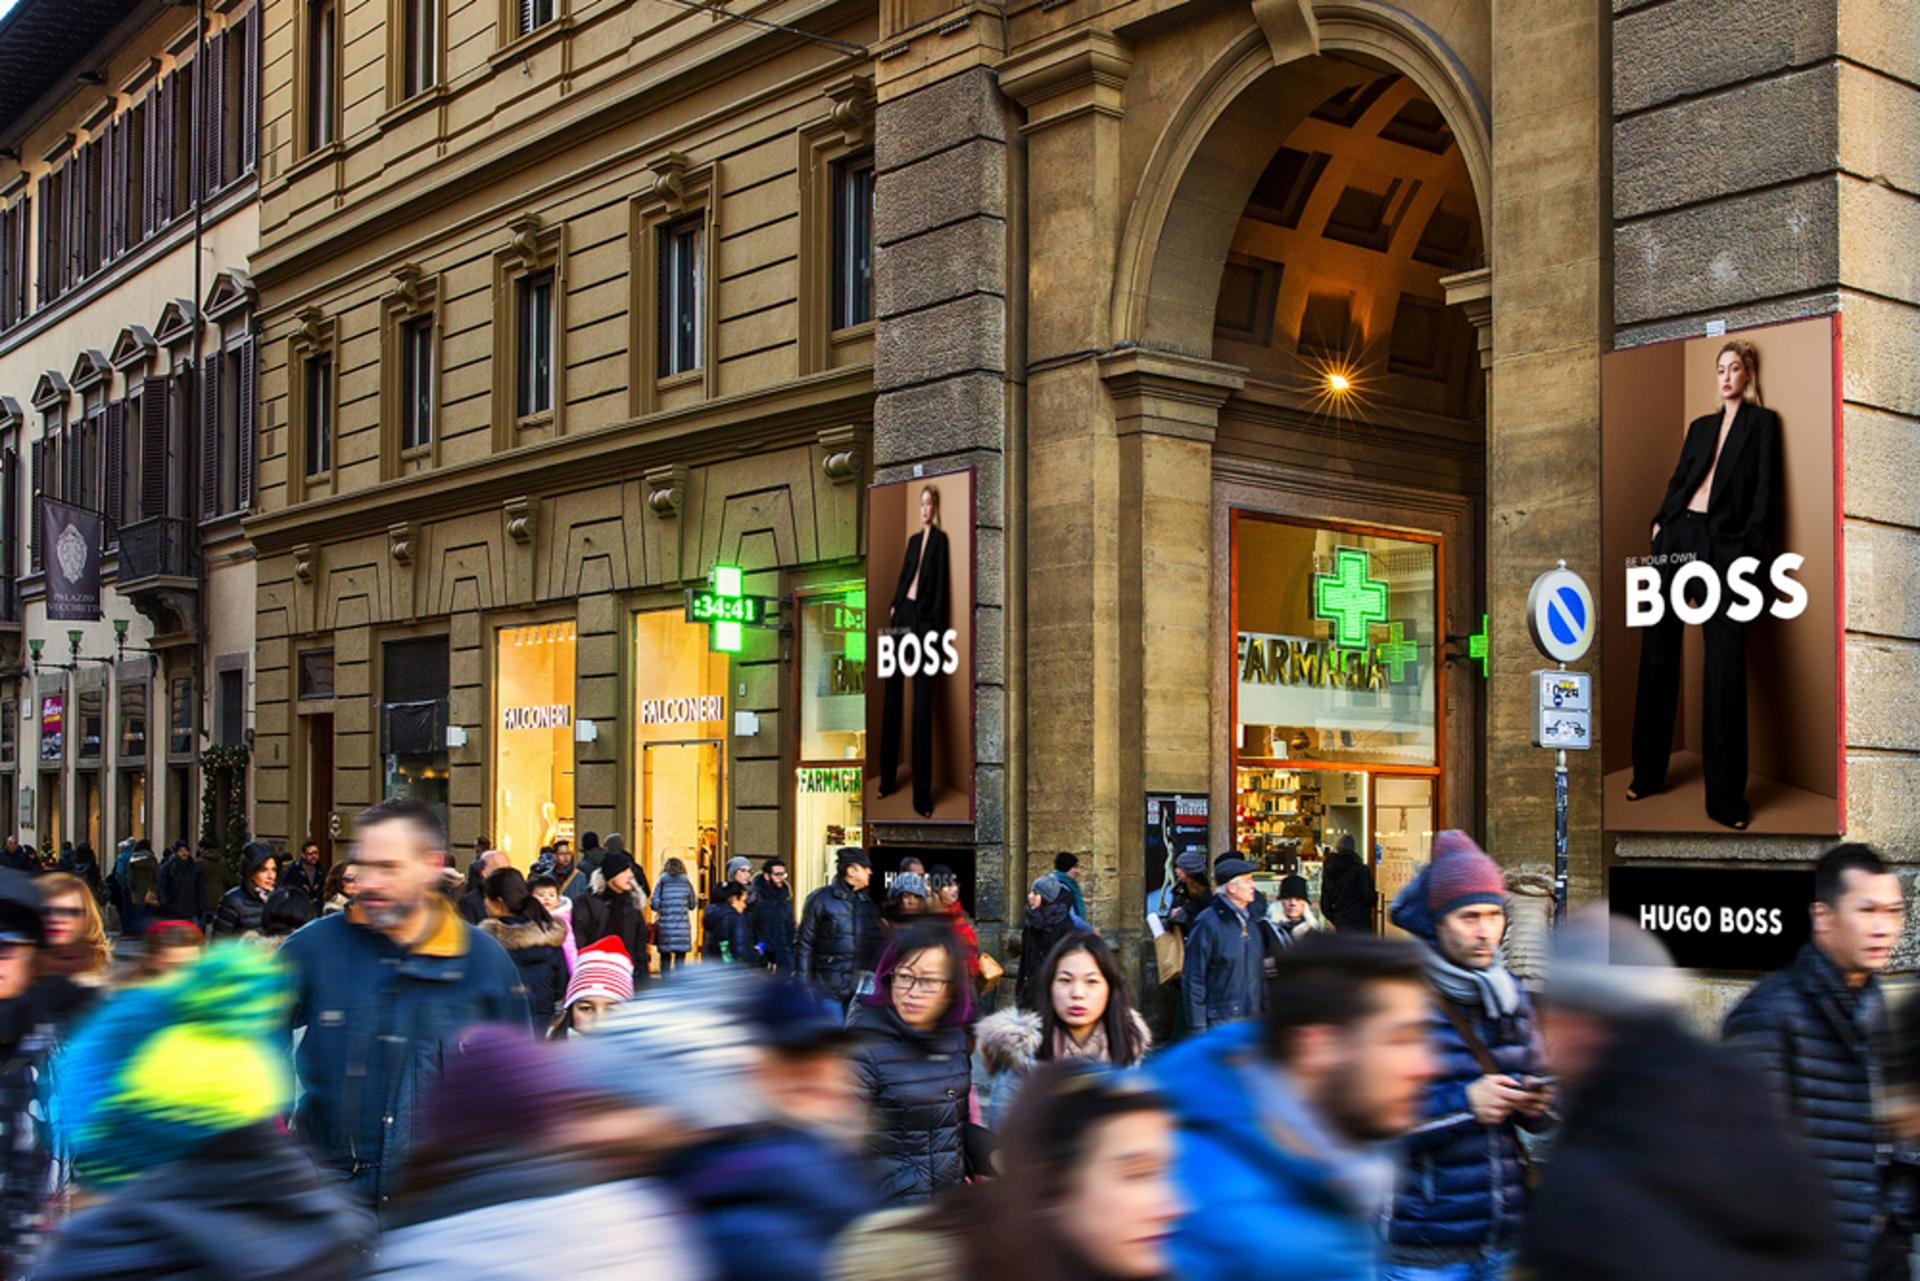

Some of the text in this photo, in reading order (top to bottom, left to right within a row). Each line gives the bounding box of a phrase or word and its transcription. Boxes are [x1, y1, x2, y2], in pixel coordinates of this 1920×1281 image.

[1639, 554, 1668, 566] YOUR
[1670, 552, 1697, 564] OWN
[1626, 552, 1808, 627] BOSS
[877, 628, 959, 678] BOSS
[503, 704, 570, 730] FALCONERI
[641, 695, 722, 725] FALCONERI
[800, 769, 862, 793] FARMACIA
[1640, 904, 1783, 935] HUGO BOSS
